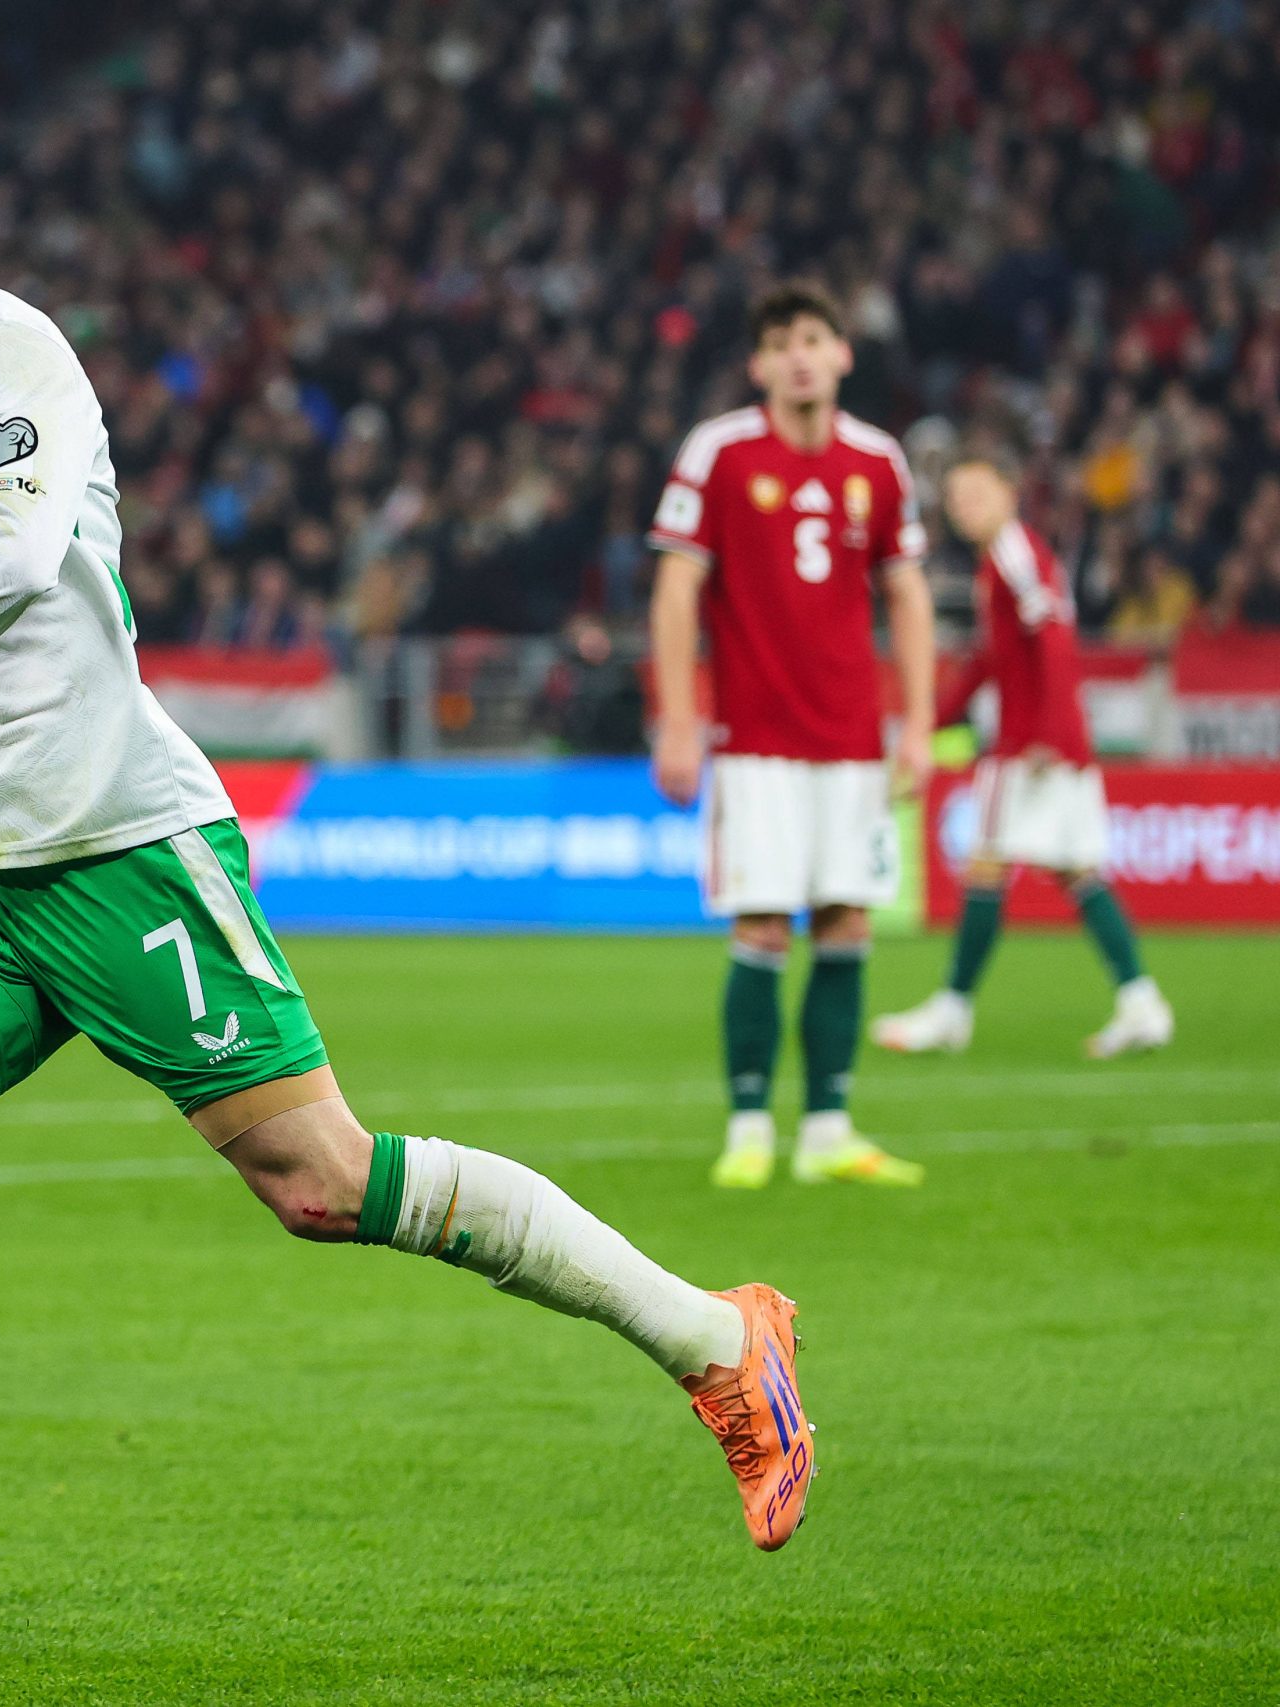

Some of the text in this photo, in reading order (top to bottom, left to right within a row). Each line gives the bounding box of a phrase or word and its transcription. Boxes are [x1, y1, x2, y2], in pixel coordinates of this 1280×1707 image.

[16, 477, 37, 494] 10
[794, 517, 832, 583] 5
[142, 918, 207, 1022] 7
[208, 1037, 251, 1065] CASTORE
[766, 1441, 807, 1538] F50
